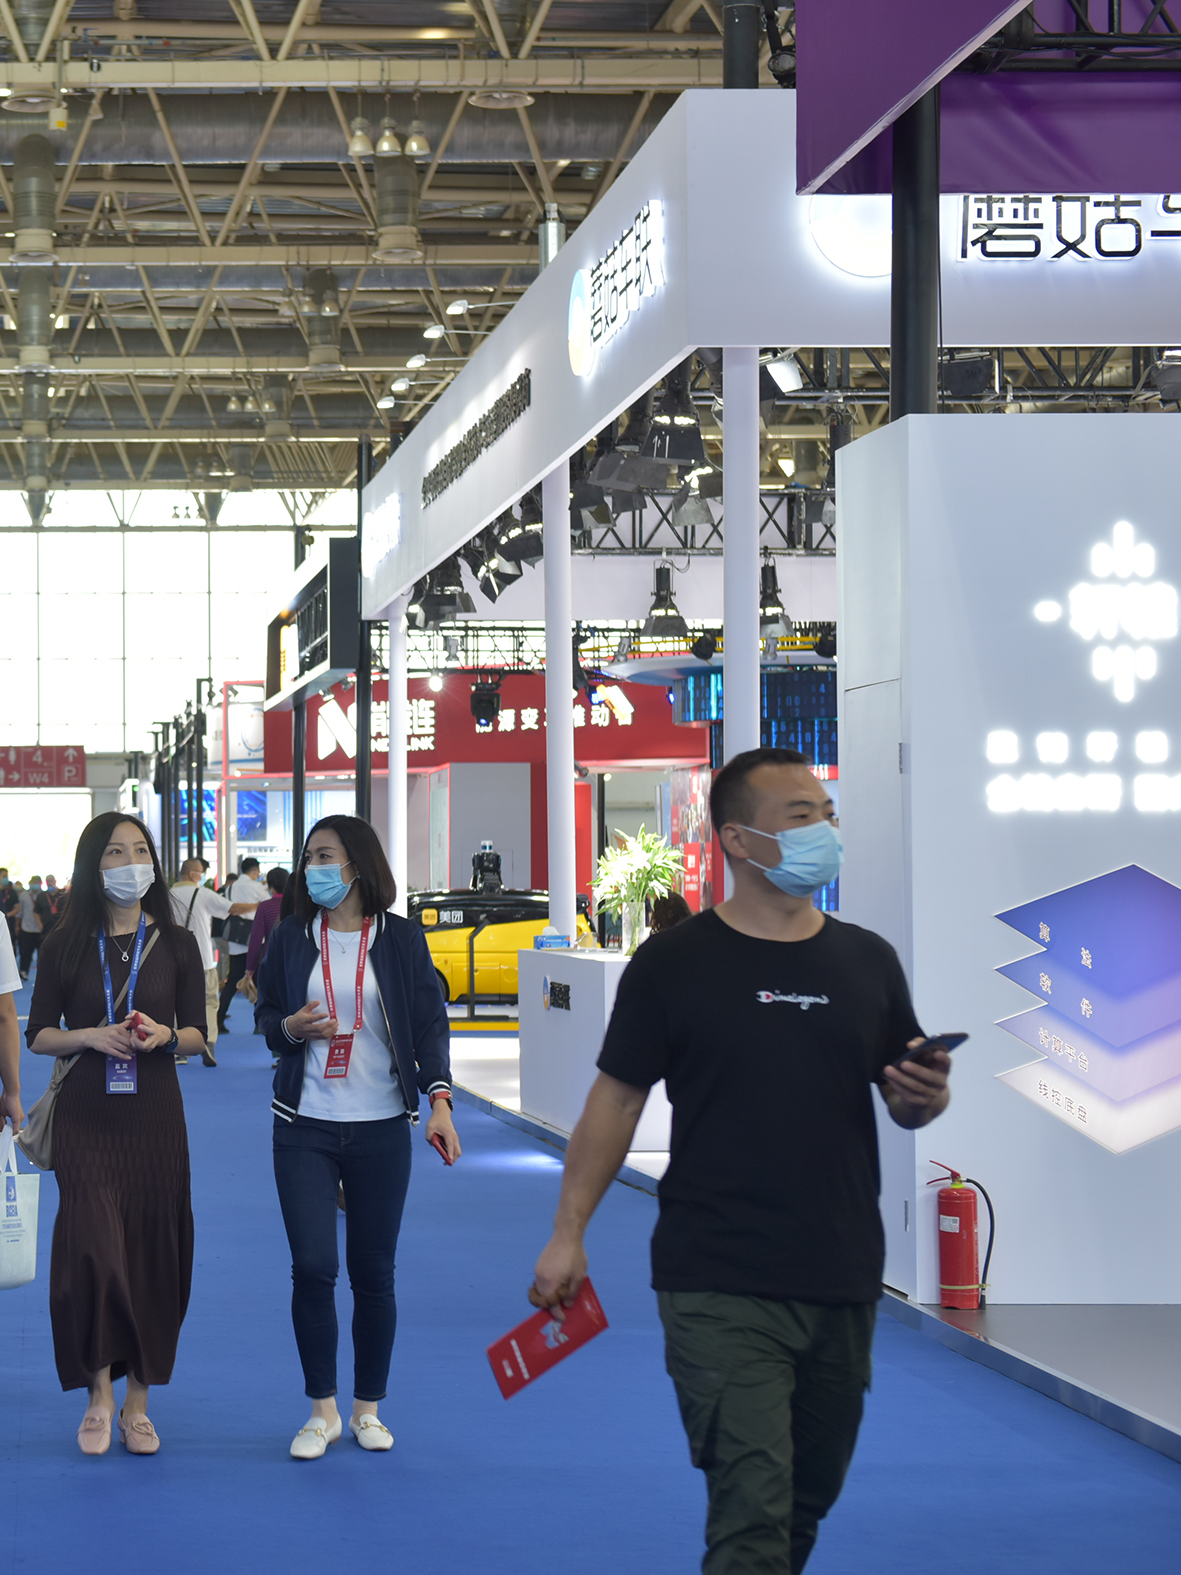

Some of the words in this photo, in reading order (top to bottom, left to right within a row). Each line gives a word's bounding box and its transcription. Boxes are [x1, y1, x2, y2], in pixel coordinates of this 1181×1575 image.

[28, 772, 49, 784] W4
[439, 910, 464, 924] 美团
[1039, 1027, 1089, 1072] 计算平台
[1038, 1078, 1089, 1125] 线控底盘
